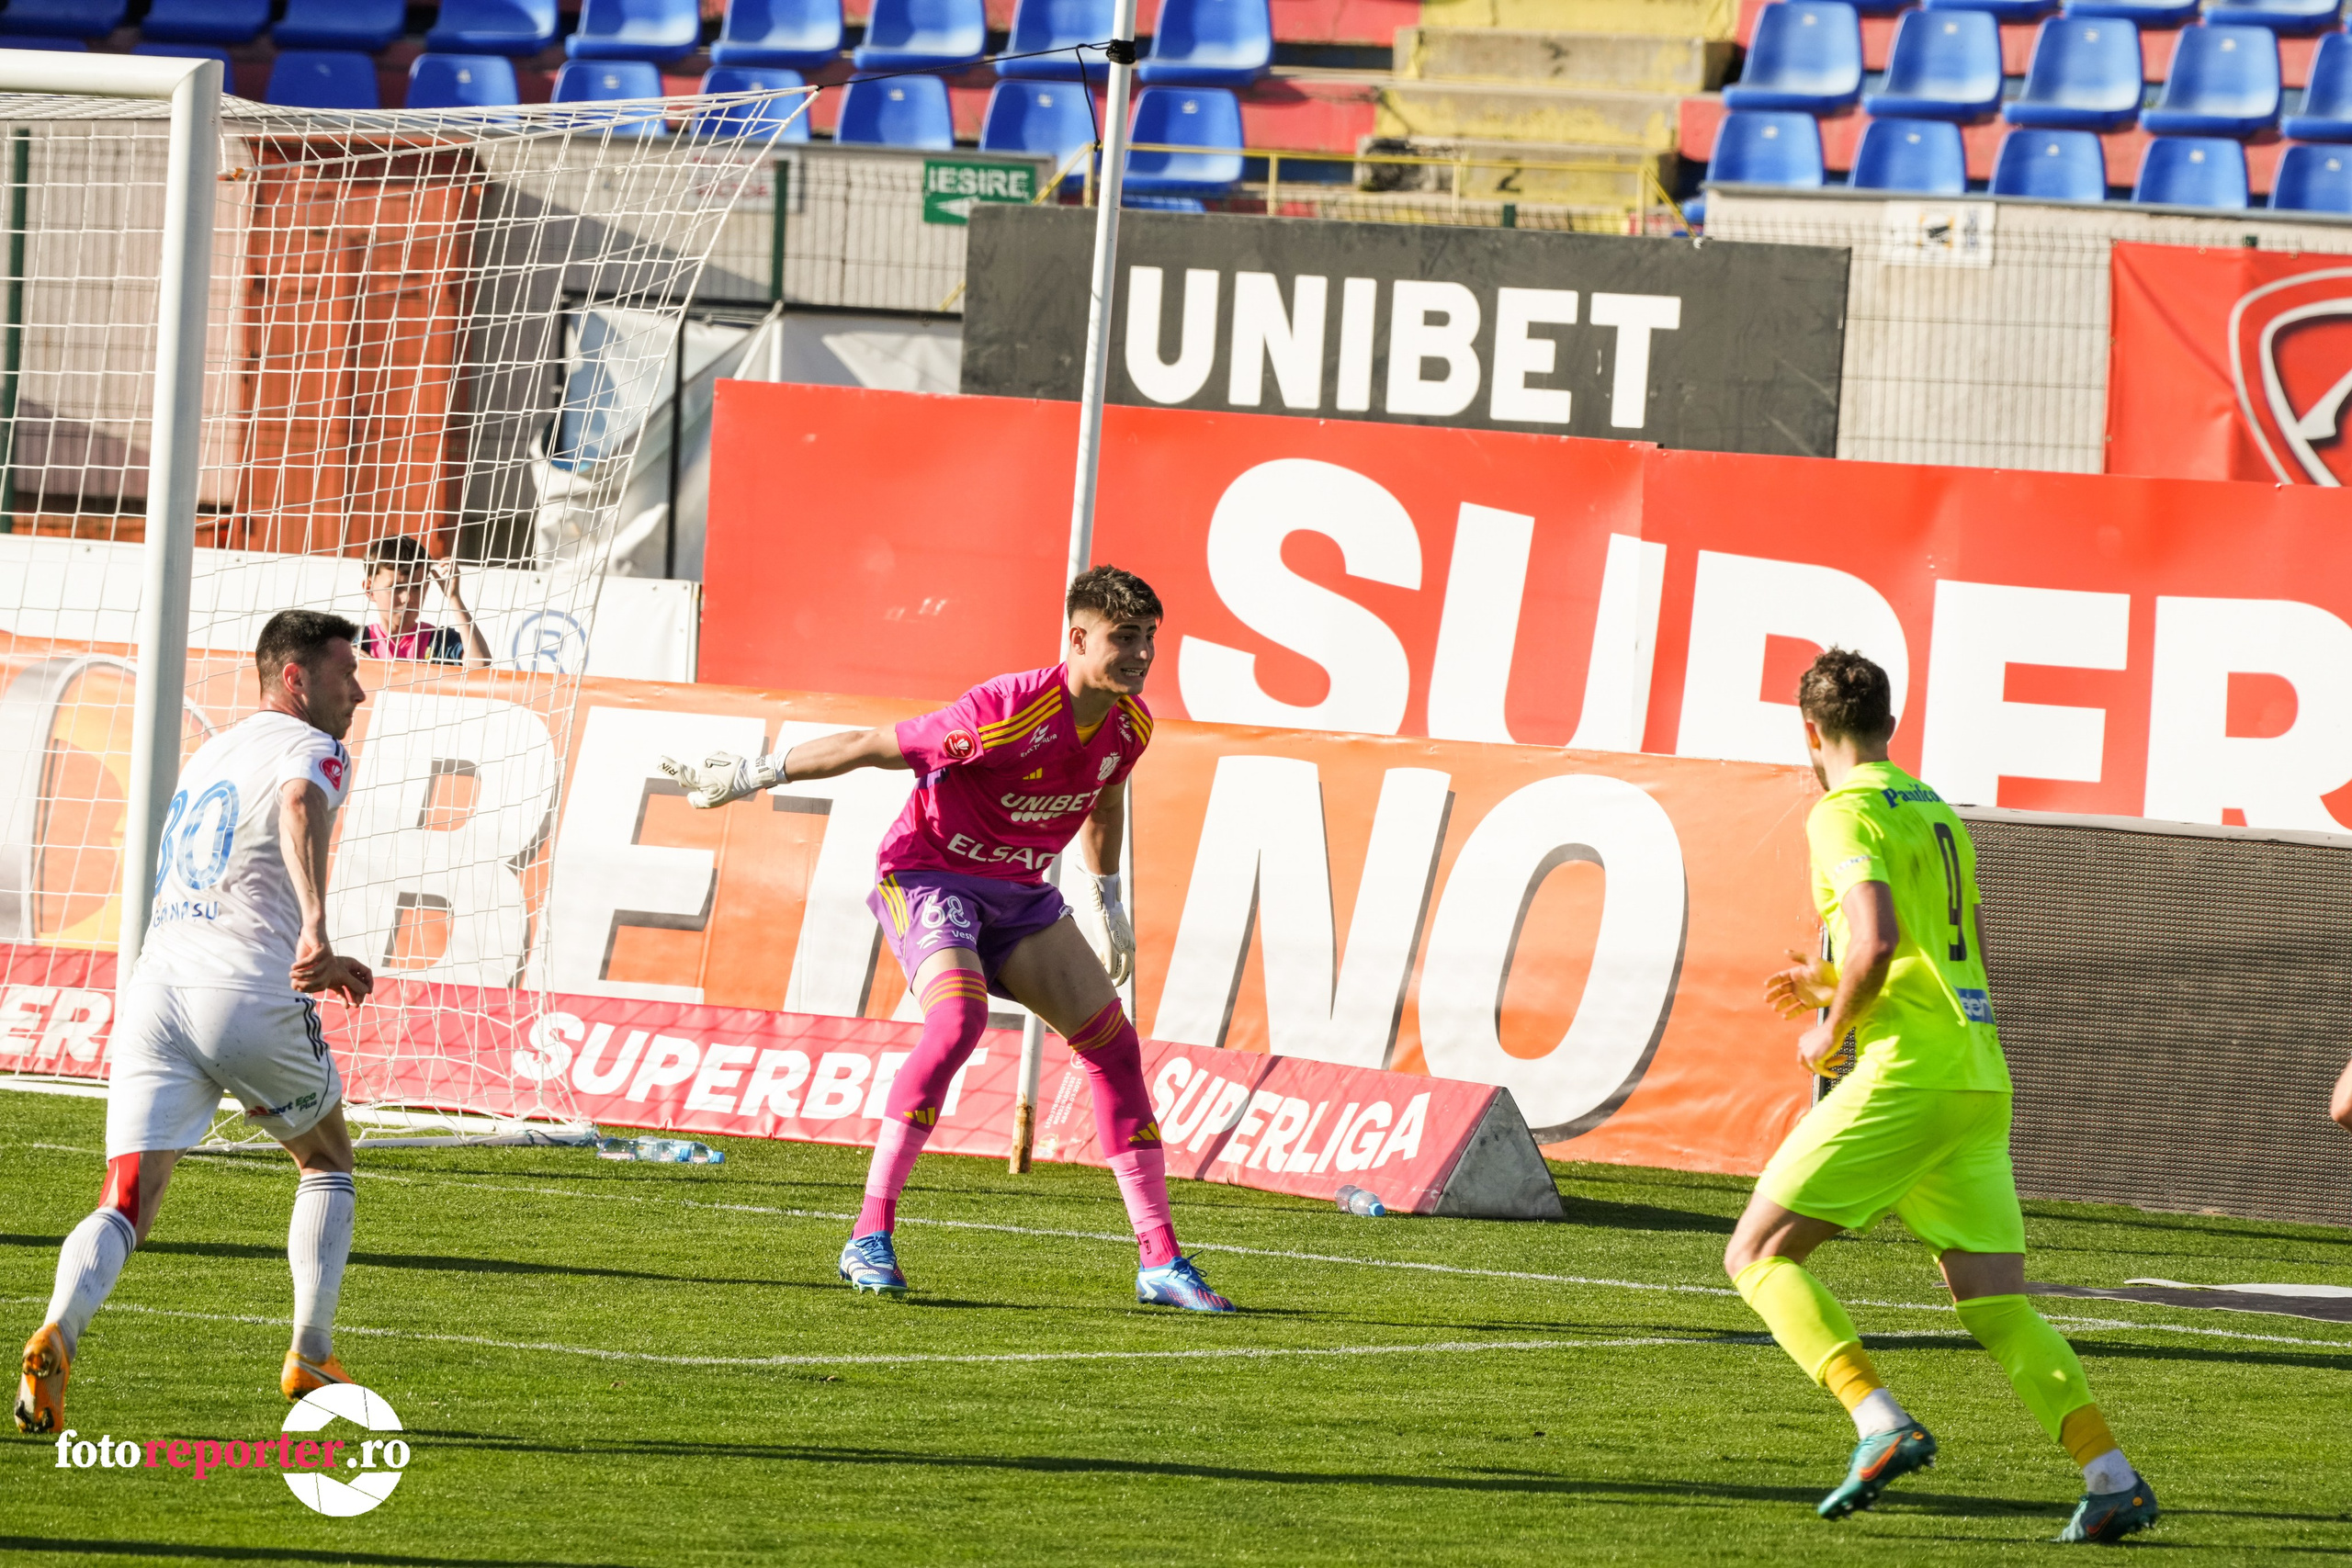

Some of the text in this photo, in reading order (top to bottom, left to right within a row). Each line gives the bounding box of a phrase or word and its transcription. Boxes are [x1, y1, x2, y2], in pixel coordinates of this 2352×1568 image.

[1125, 265, 1681, 428] UNIBET
[1001, 786, 1102, 813] UNIBET
[324, 691, 1689, 1144] BETNO
[921, 895, 971, 930] 68
[1933, 822, 1967, 962] 9
[513, 1012, 989, 1120] SUPERBET
[1151, 1056, 1431, 1173] SUPERLIGA
